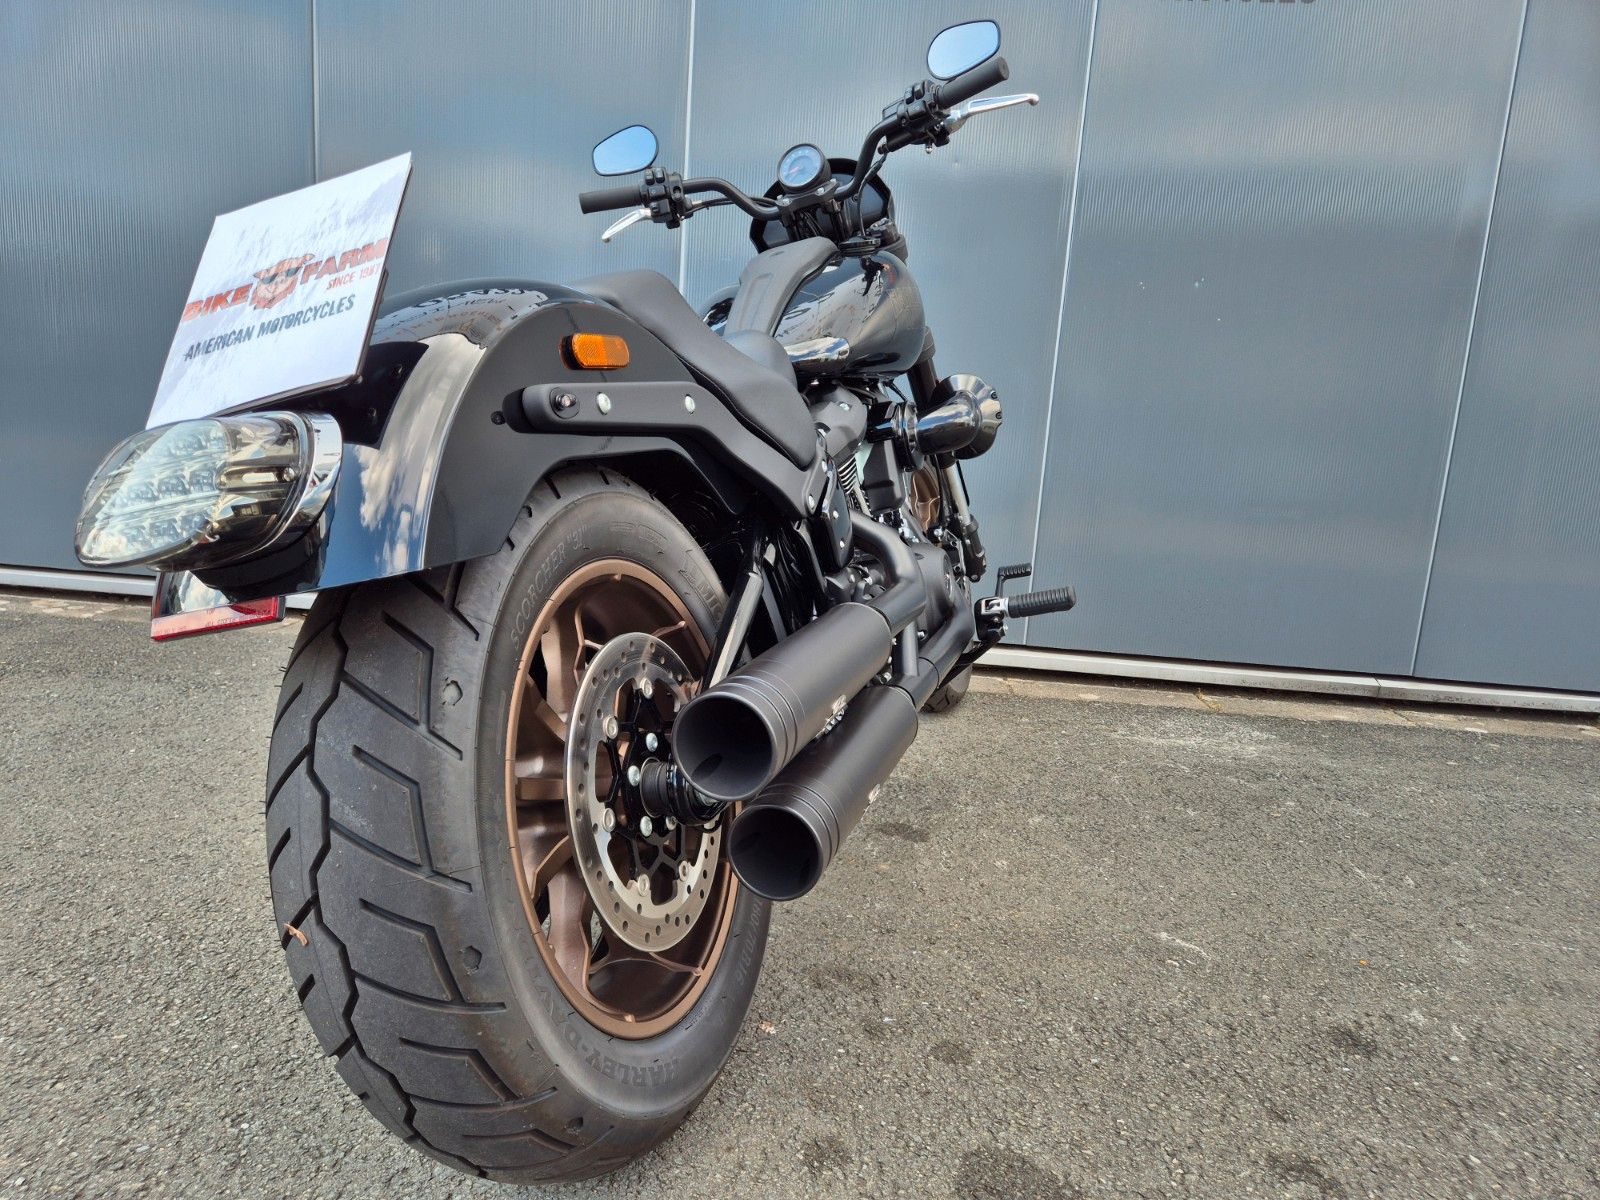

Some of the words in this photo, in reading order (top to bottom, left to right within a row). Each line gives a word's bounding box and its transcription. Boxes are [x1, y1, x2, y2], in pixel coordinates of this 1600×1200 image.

[181, 283, 253, 324] BIKE
[300, 238, 388, 285] FARM
[326, 271, 356, 290] SINCE
[184, 325, 255, 361] AMERICAN
[257, 294, 355, 338] MOTORCYCLES
[510, 542, 566, 650] SCORCHER
